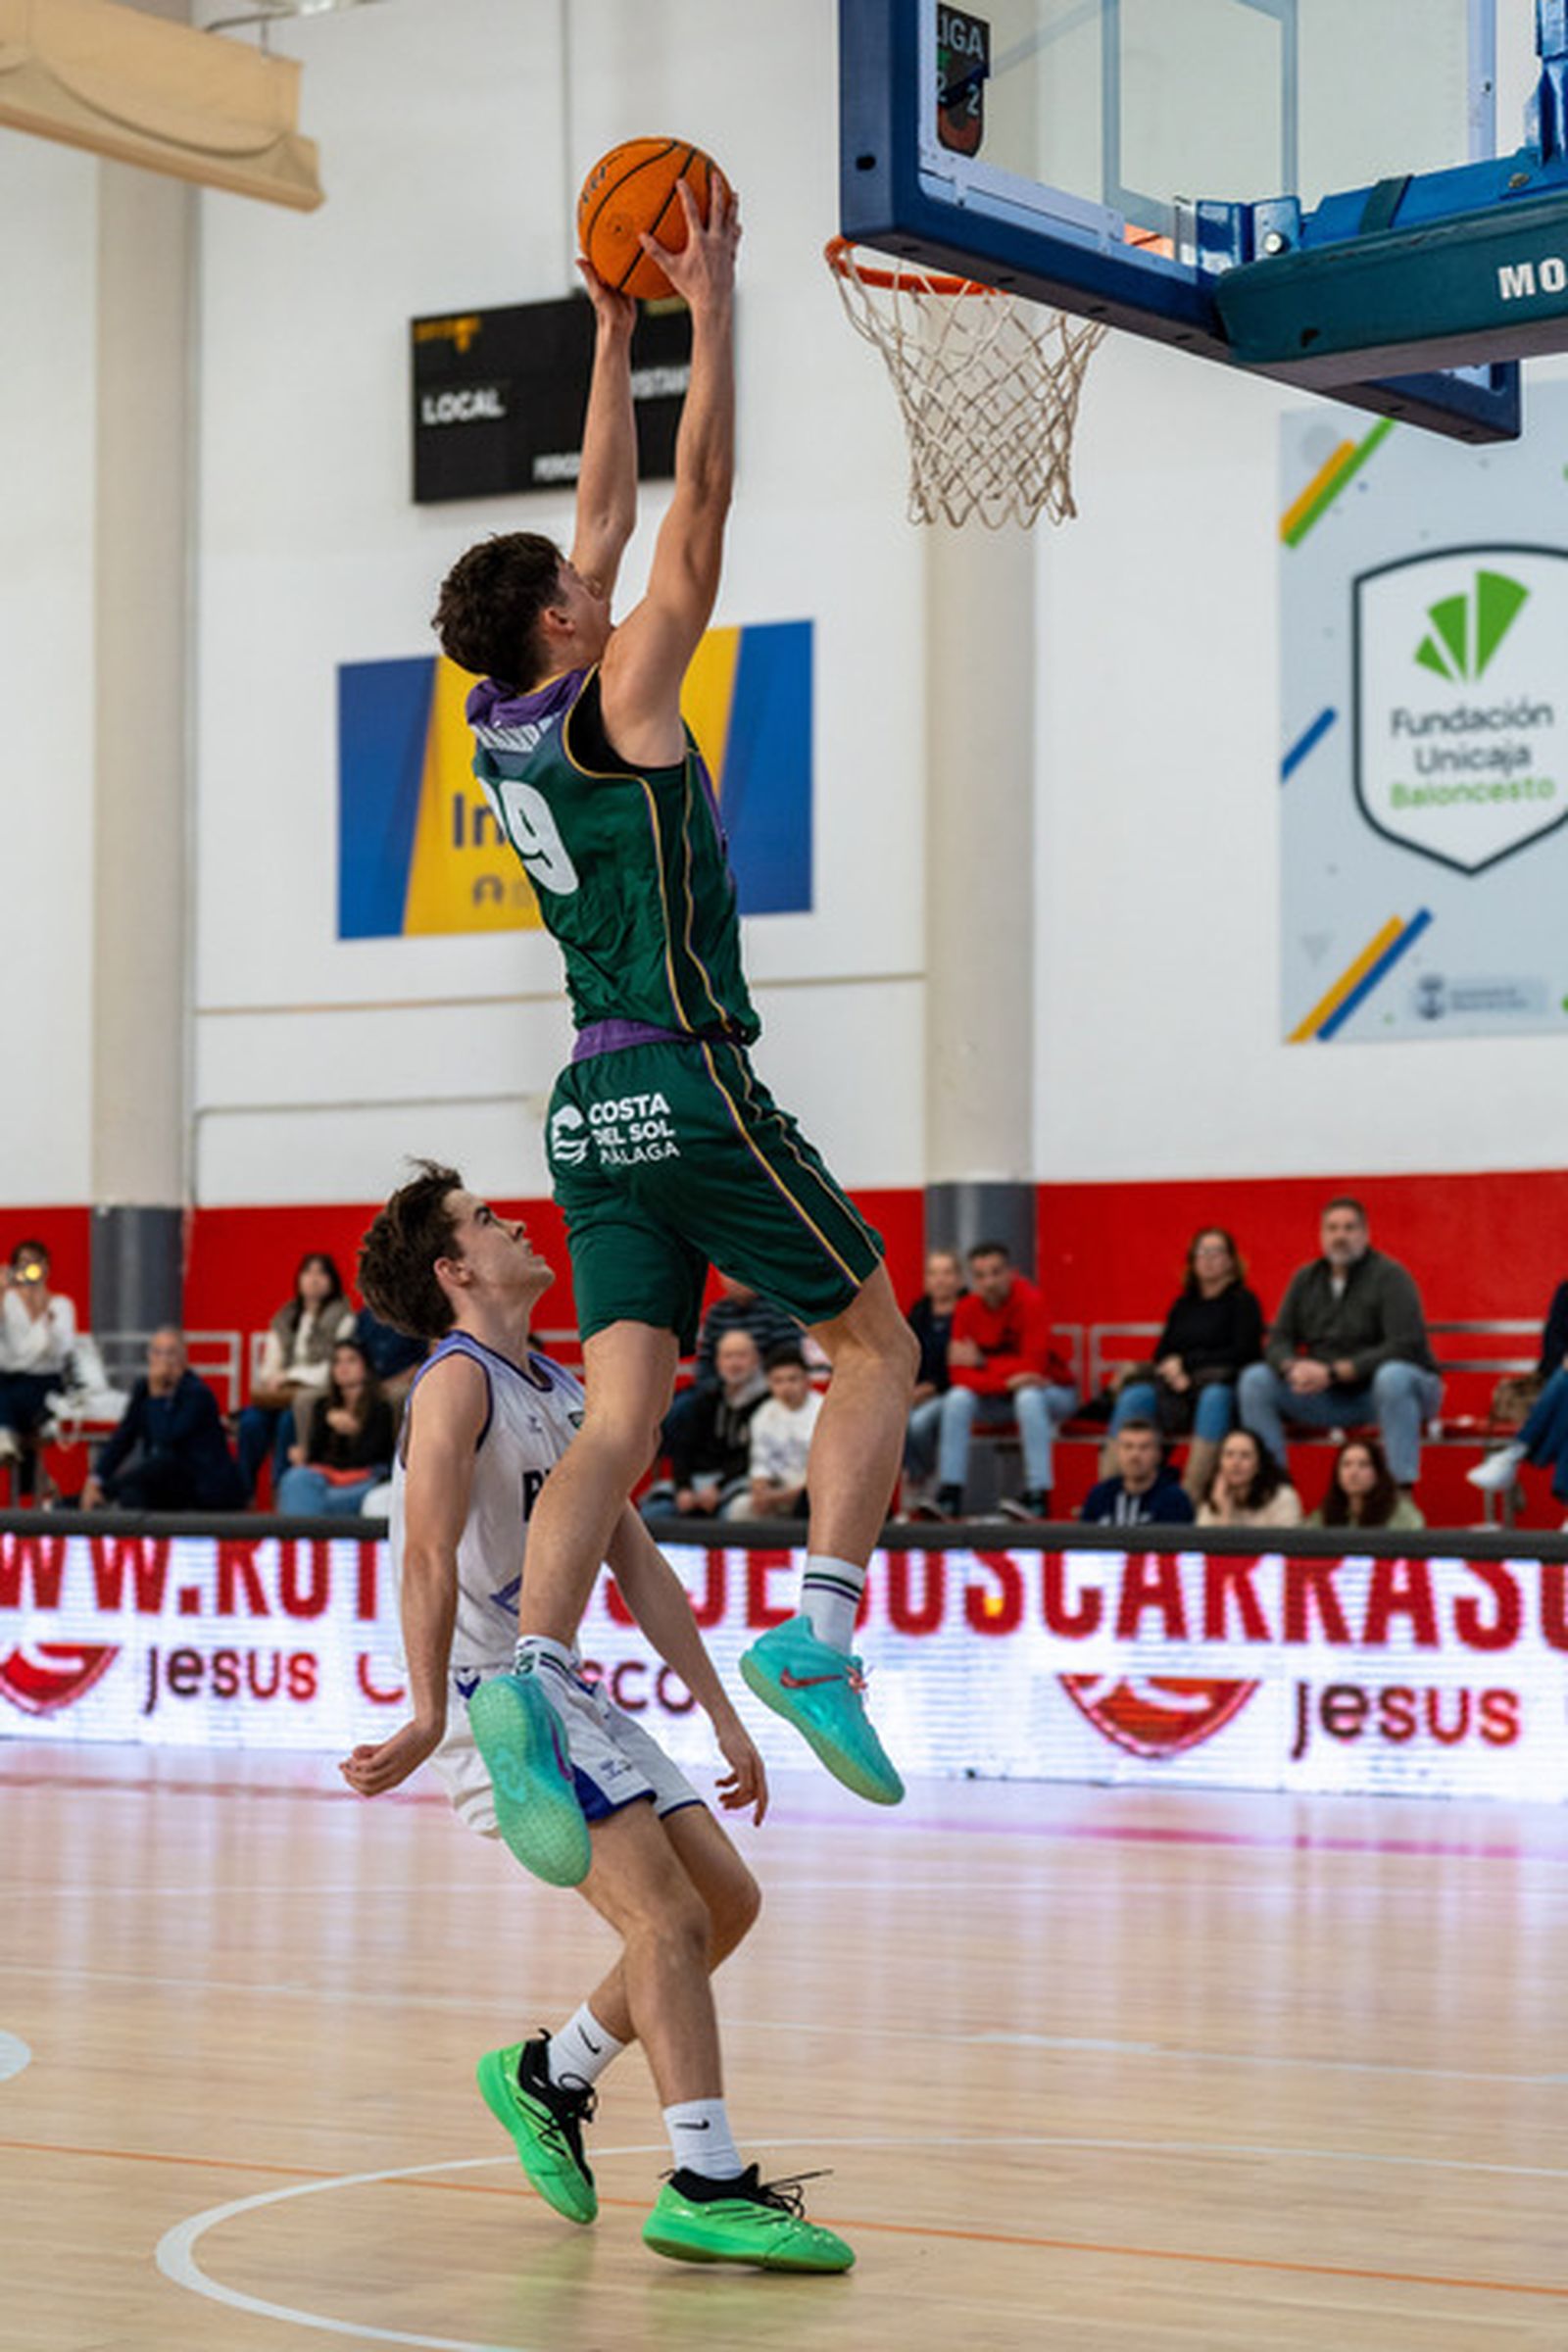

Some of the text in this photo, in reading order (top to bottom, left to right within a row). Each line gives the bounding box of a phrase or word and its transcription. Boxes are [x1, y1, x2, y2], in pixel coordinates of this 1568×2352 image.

[421, 389, 505, 424] LOCAL
[1391, 697, 1554, 738] Fundación
[1414, 738, 1533, 777] Unicaja
[589, 1093, 670, 1125] COSTA
[628, 1119, 676, 1144] SOL
